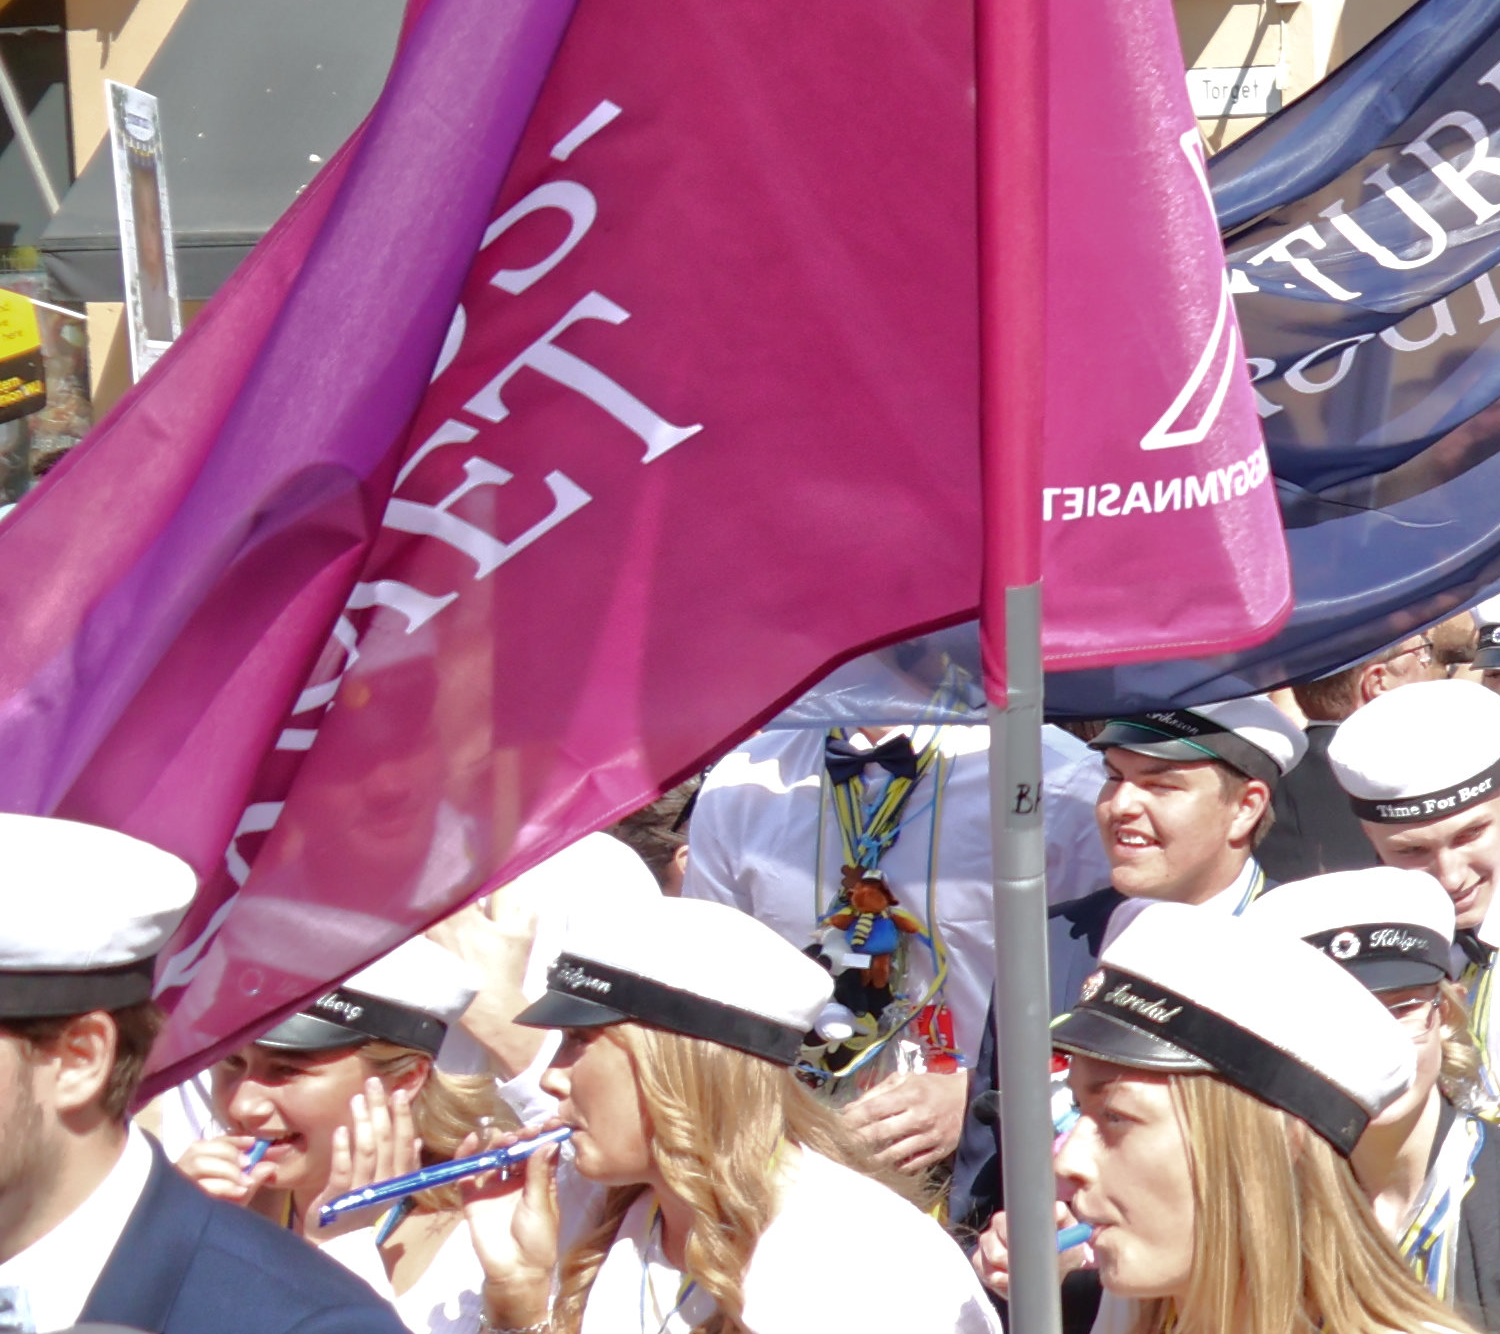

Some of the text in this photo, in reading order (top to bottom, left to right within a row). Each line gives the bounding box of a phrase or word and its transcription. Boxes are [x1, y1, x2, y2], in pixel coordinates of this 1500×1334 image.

[1202, 79, 1259, 105] Torget
[1376, 777, 1494, 818] Time For Beer
